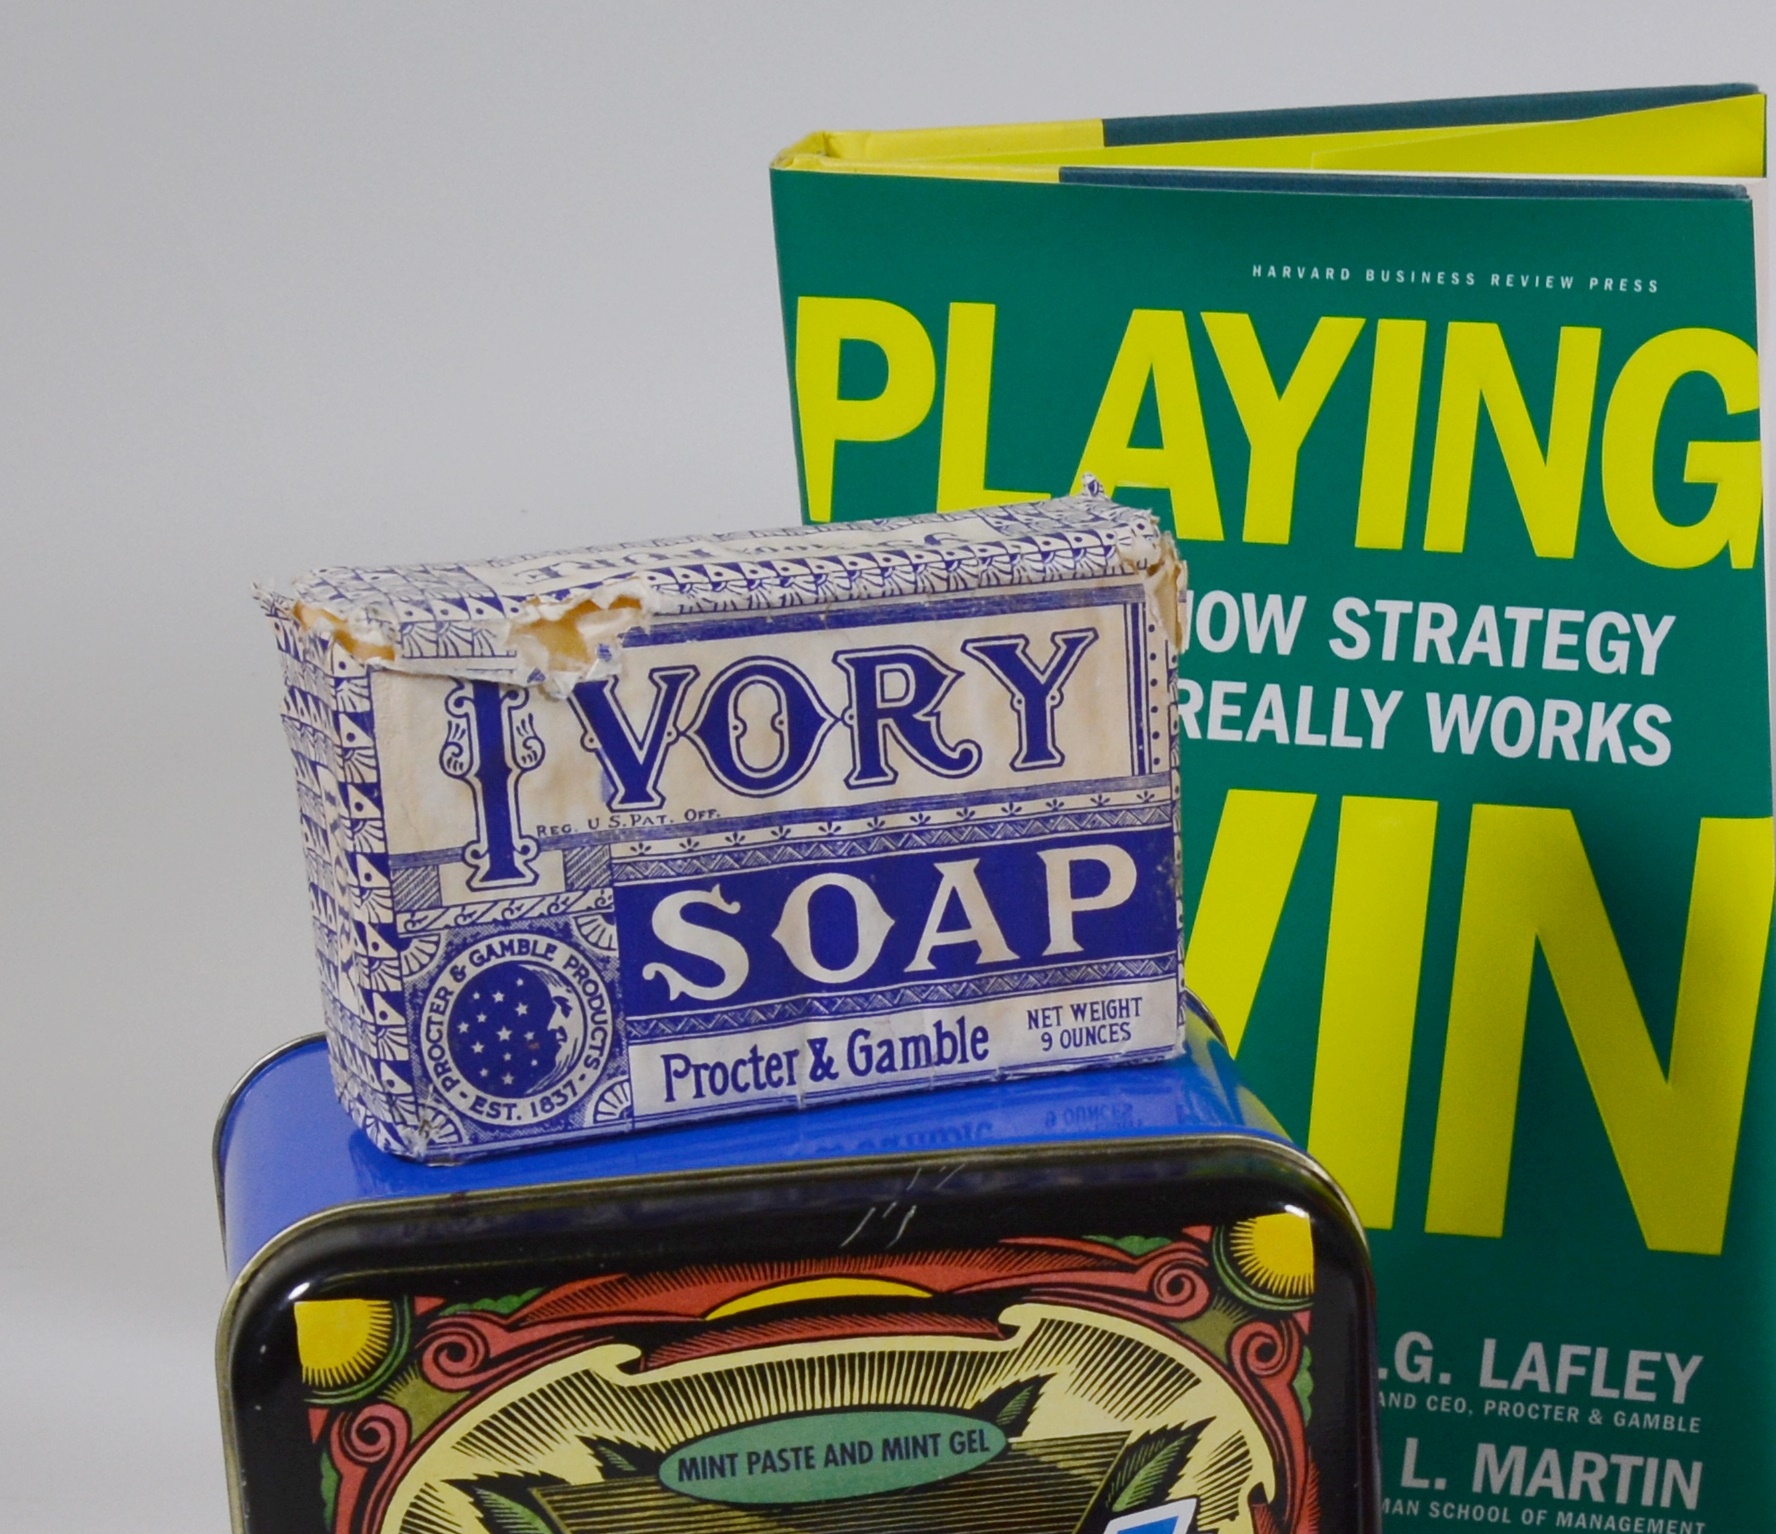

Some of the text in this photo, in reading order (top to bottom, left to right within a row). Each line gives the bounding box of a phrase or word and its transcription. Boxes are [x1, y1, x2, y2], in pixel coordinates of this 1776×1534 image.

[1251, 263, 1661, 296] HARVARD BUSINESS REVIEW PRESS
[795, 295, 1766, 570] PLAYING
[1185, 589, 1677, 677] OW STRATEGY
[438, 625, 1102, 892] IVORY
[1177, 677, 1673, 767] REALLY WORKS
[642, 843, 1139, 1002] SOAP
[425, 938, 608, 1093] PROCTER & GAMBLE PRODUCTS
[1026, 997, 1145, 1032] NET WEIGHT
[1040, 1021, 1133, 1051] 9 OUNCES
[661, 1018, 990, 1103] Procter & Gamble
[468, 1078, 578, 1121] EST. 1837
[1377, 1330, 1704, 1406] .G. LAFLEY
[1426, 1394, 1474, 1417] CEO,
[1483, 1400, 1579, 1424] PROCTER
[1588, 1408, 1603, 1426] &
[1613, 1410, 1702, 1434] GAMBLE
[677, 1430, 992, 1484] MINT PASTE AND MINT GEL
[1400, 1436, 1703, 1511] L. MARTIN
[1428, 1501, 1513, 1525] SCHOOL
[1521, 1507, 1548, 1526] OF
